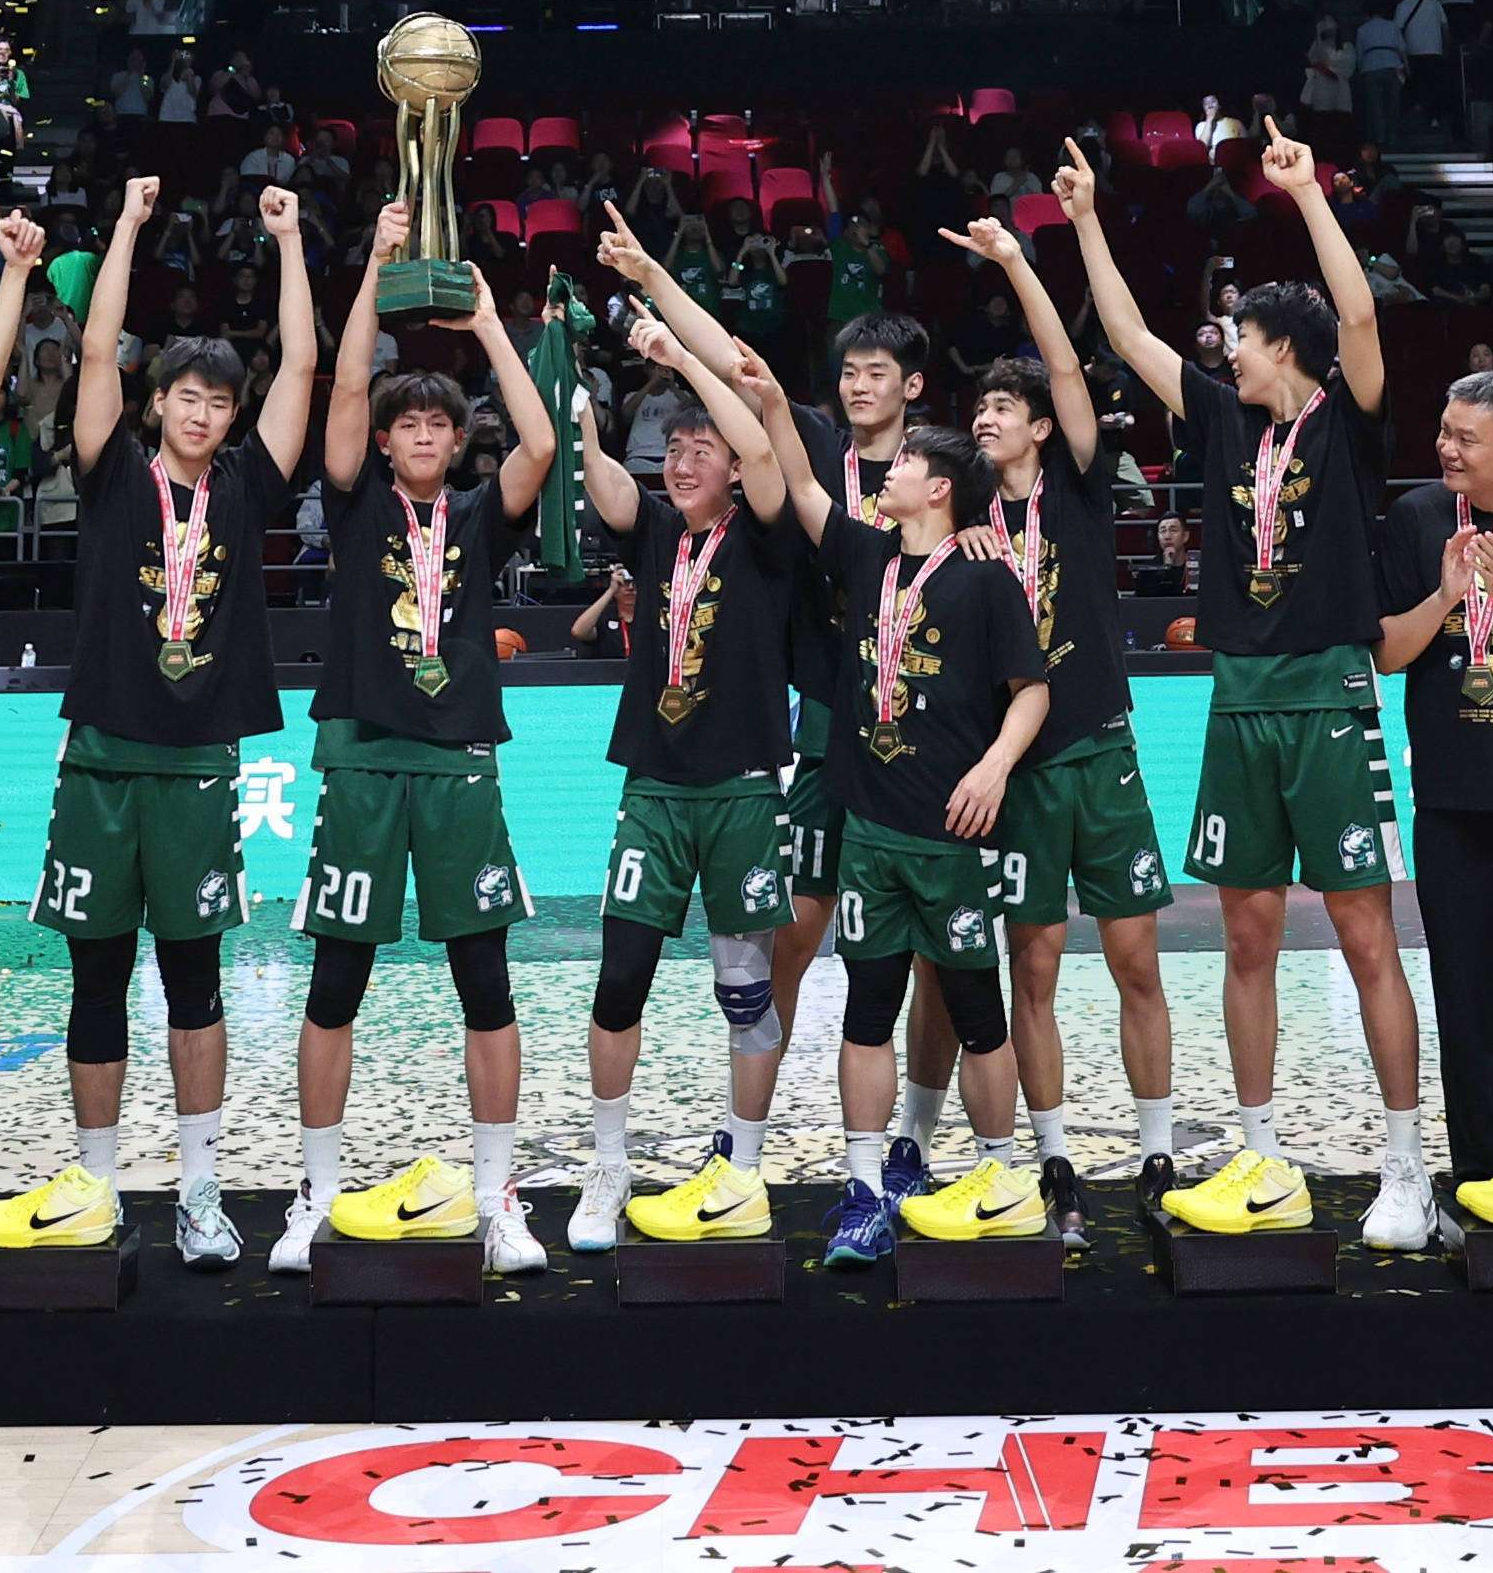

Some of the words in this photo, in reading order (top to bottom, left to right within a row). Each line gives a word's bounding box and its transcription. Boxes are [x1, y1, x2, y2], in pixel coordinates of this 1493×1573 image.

[48, 859, 93, 921] 32
[316, 863, 373, 925] 20
[614, 848, 646, 903] 6
